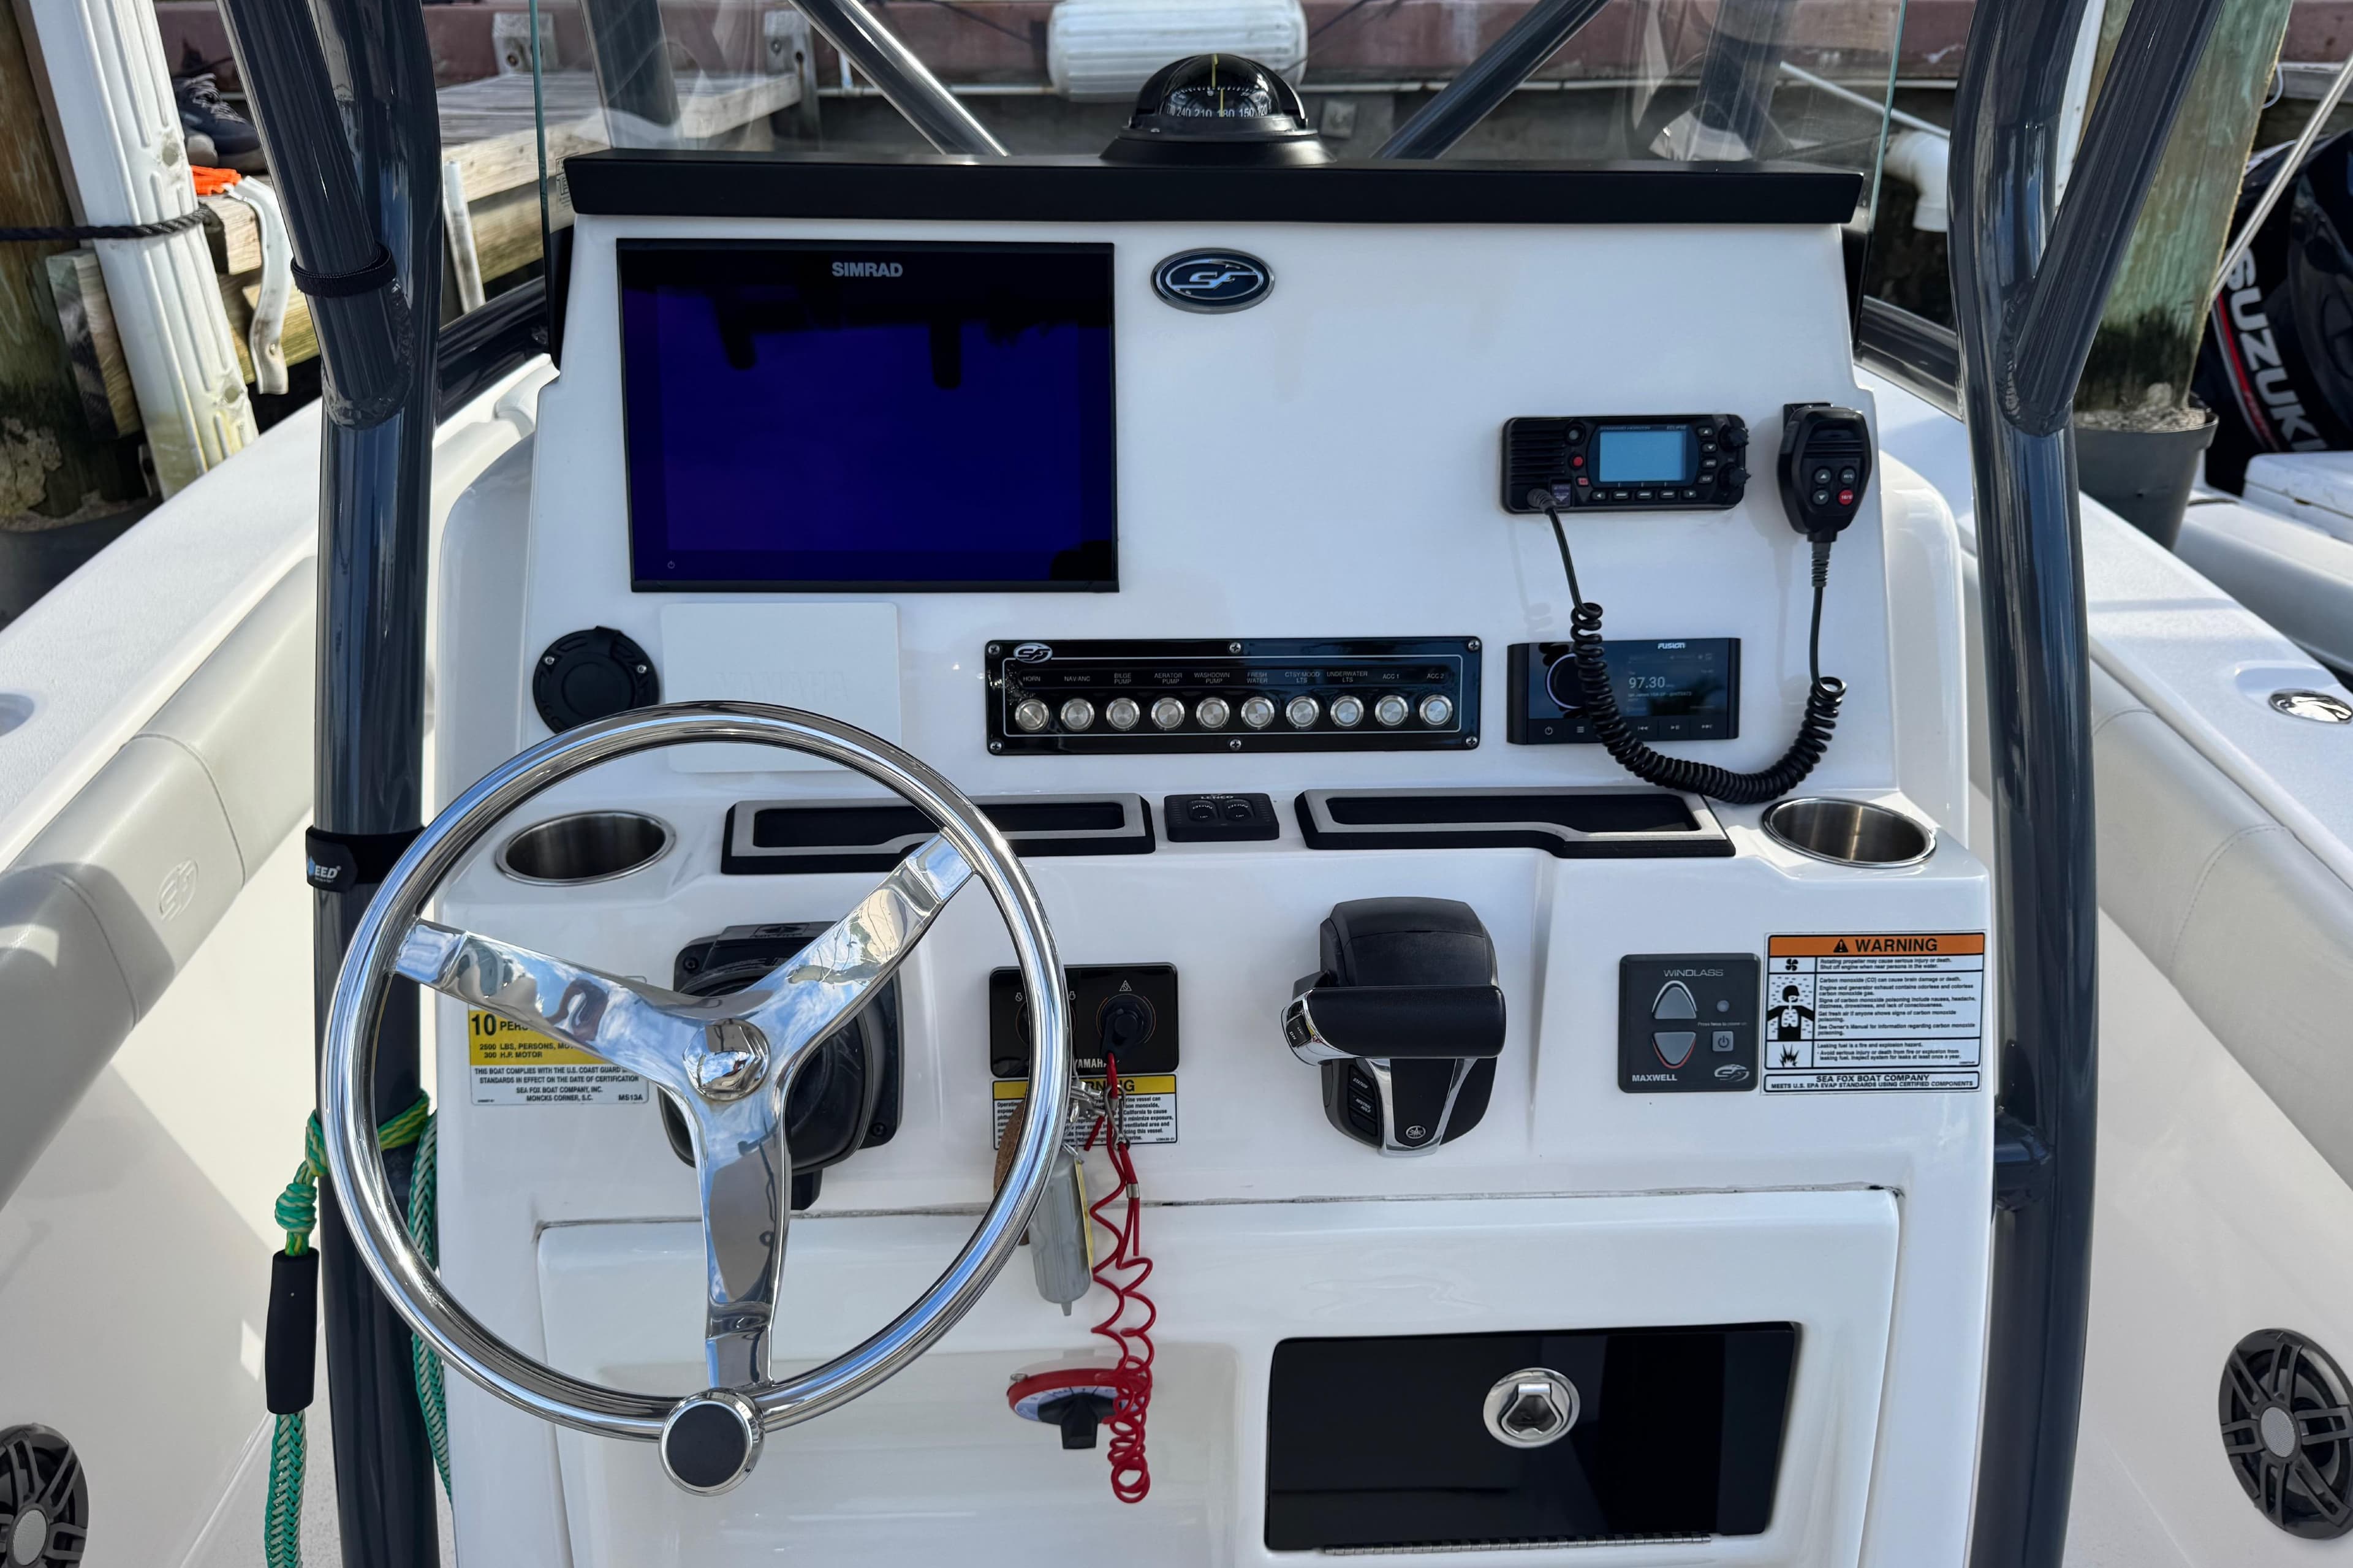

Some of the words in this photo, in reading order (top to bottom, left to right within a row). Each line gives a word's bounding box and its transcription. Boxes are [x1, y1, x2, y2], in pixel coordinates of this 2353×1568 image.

[1176, 108, 1191, 117] 240
[1239, 108, 1254, 117] 150
[832, 262, 903, 277] SIMRAD
[2226, 246, 2328, 452] SUZUKI
[1629, 676, 1665, 689] 97.30
[1855, 937, 1938, 953] WARNING
[1663, 969, 1724, 977] WINDLASS
[471, 1013, 497, 1036] 10
[1074, 1058, 1107, 1069] YAMAH
[1352, 1078, 1368, 1089] STATION
